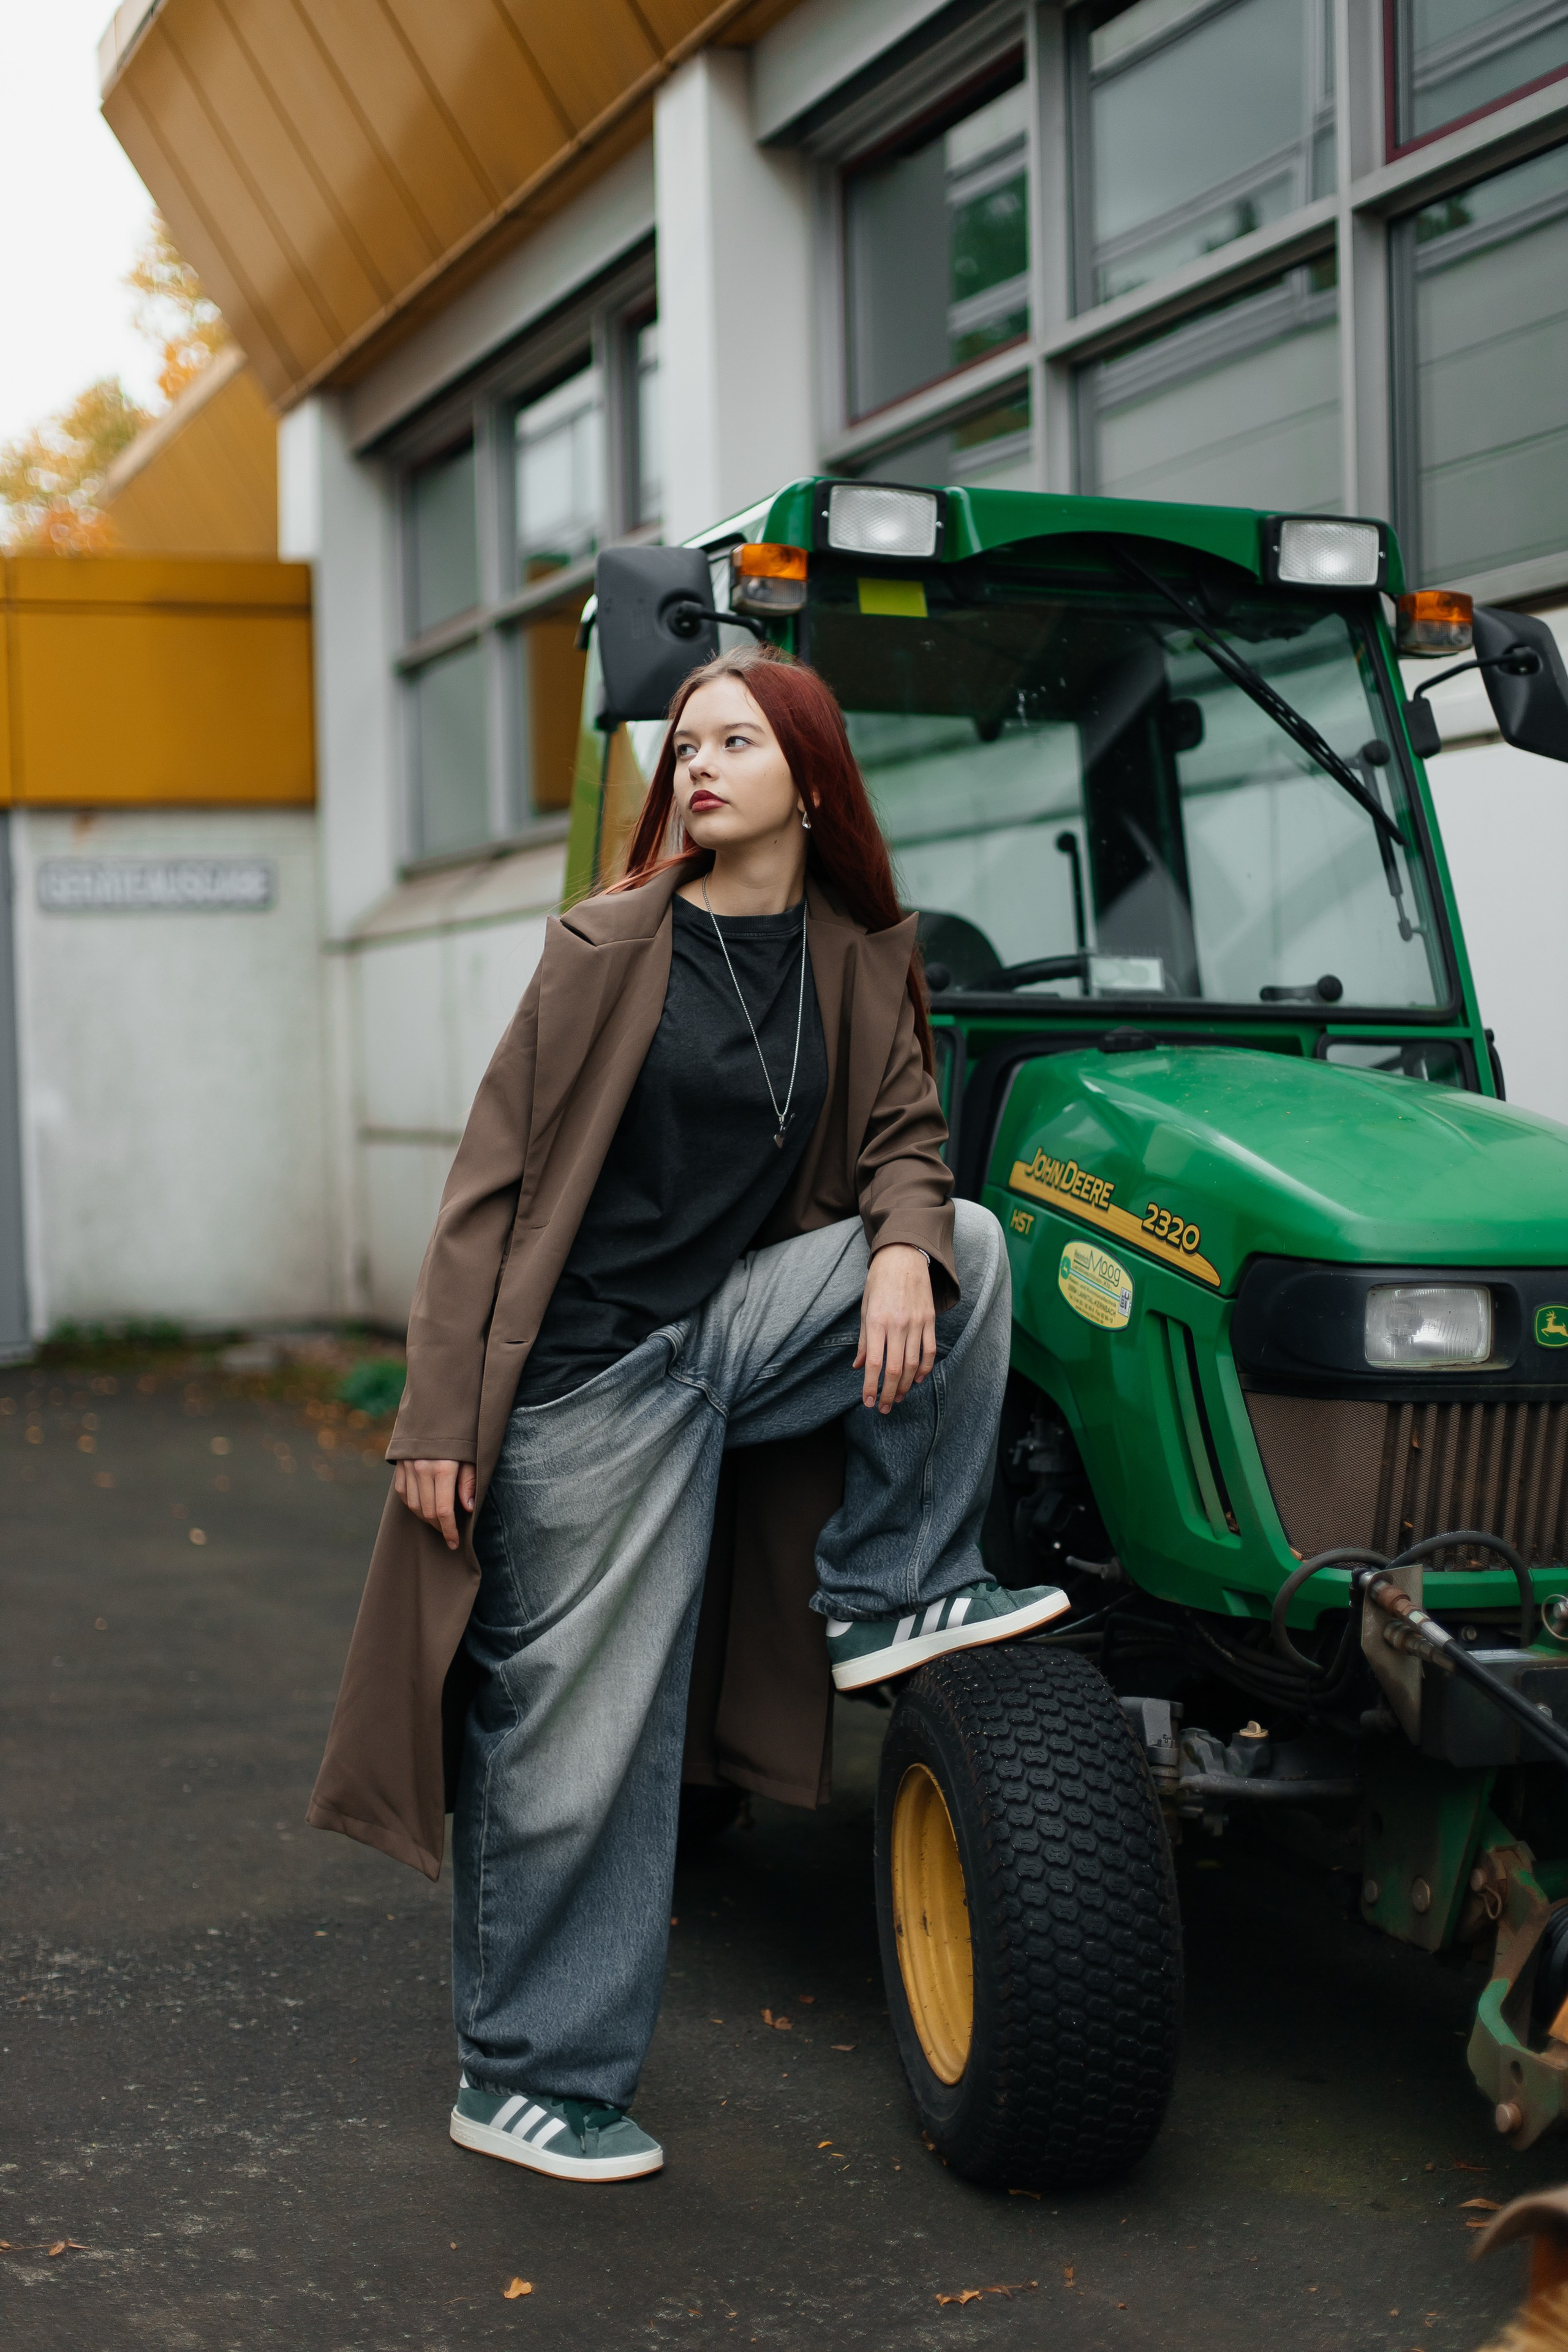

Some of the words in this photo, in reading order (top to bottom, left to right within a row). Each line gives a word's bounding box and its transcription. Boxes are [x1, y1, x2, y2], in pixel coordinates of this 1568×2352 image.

[1060, 1160, 1115, 1208] DEERE
[1010, 1209, 1034, 1235] HST
[1142, 1202, 1200, 1254] 2320
[1087, 1250, 1121, 1287] Moog
